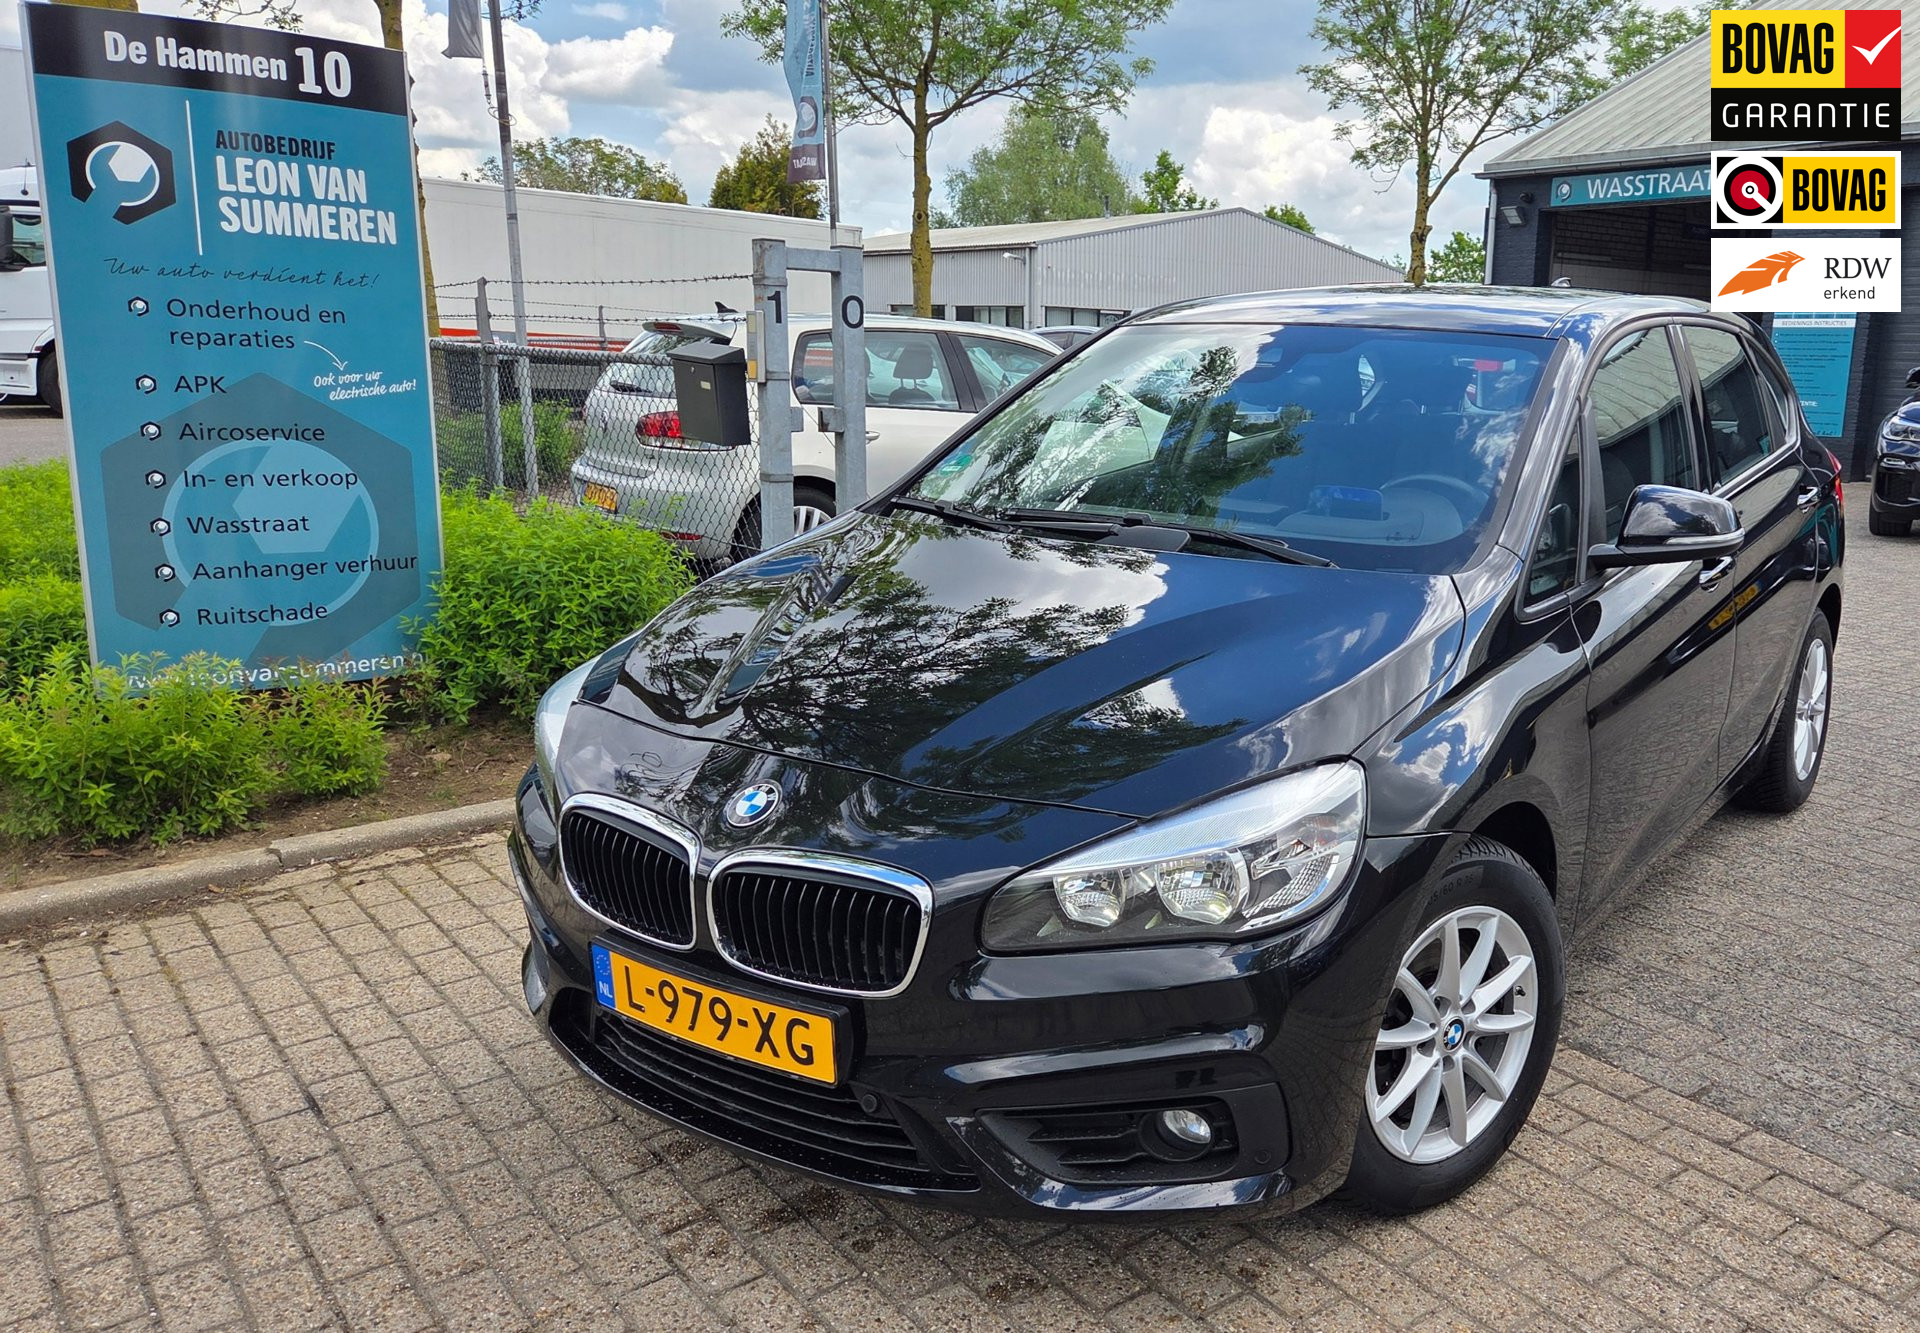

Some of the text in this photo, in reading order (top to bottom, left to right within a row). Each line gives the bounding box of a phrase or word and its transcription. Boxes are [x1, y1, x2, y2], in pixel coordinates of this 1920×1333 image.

[104, 31, 351, 98] De Hammen 10
[215, 129, 336, 161] AUTOBEDRIJF
[215, 155, 367, 204] LEON VAN
[218, 196, 397, 245] SUMMEREN
[103, 258, 381, 288] Uw auto verdient het!
[166, 298, 346, 324] Onderhoud en
[767, 290, 782, 324] 1
[169, 329, 296, 350] reparaties
[174, 375, 228, 394] APK
[313, 371, 383, 388] Ook voor uw
[329, 379, 417, 400] electrische auto!
[179, 422, 325, 441] Aircoservice
[183, 468, 358, 490] In- en verkoop
[187, 515, 310, 535] Wasstraat
[192, 554, 418, 582] Aanhanger verhuur
[197, 603, 328, 626] Ruitschade
[599, 965, 814, 1066] NL L-979-XG
